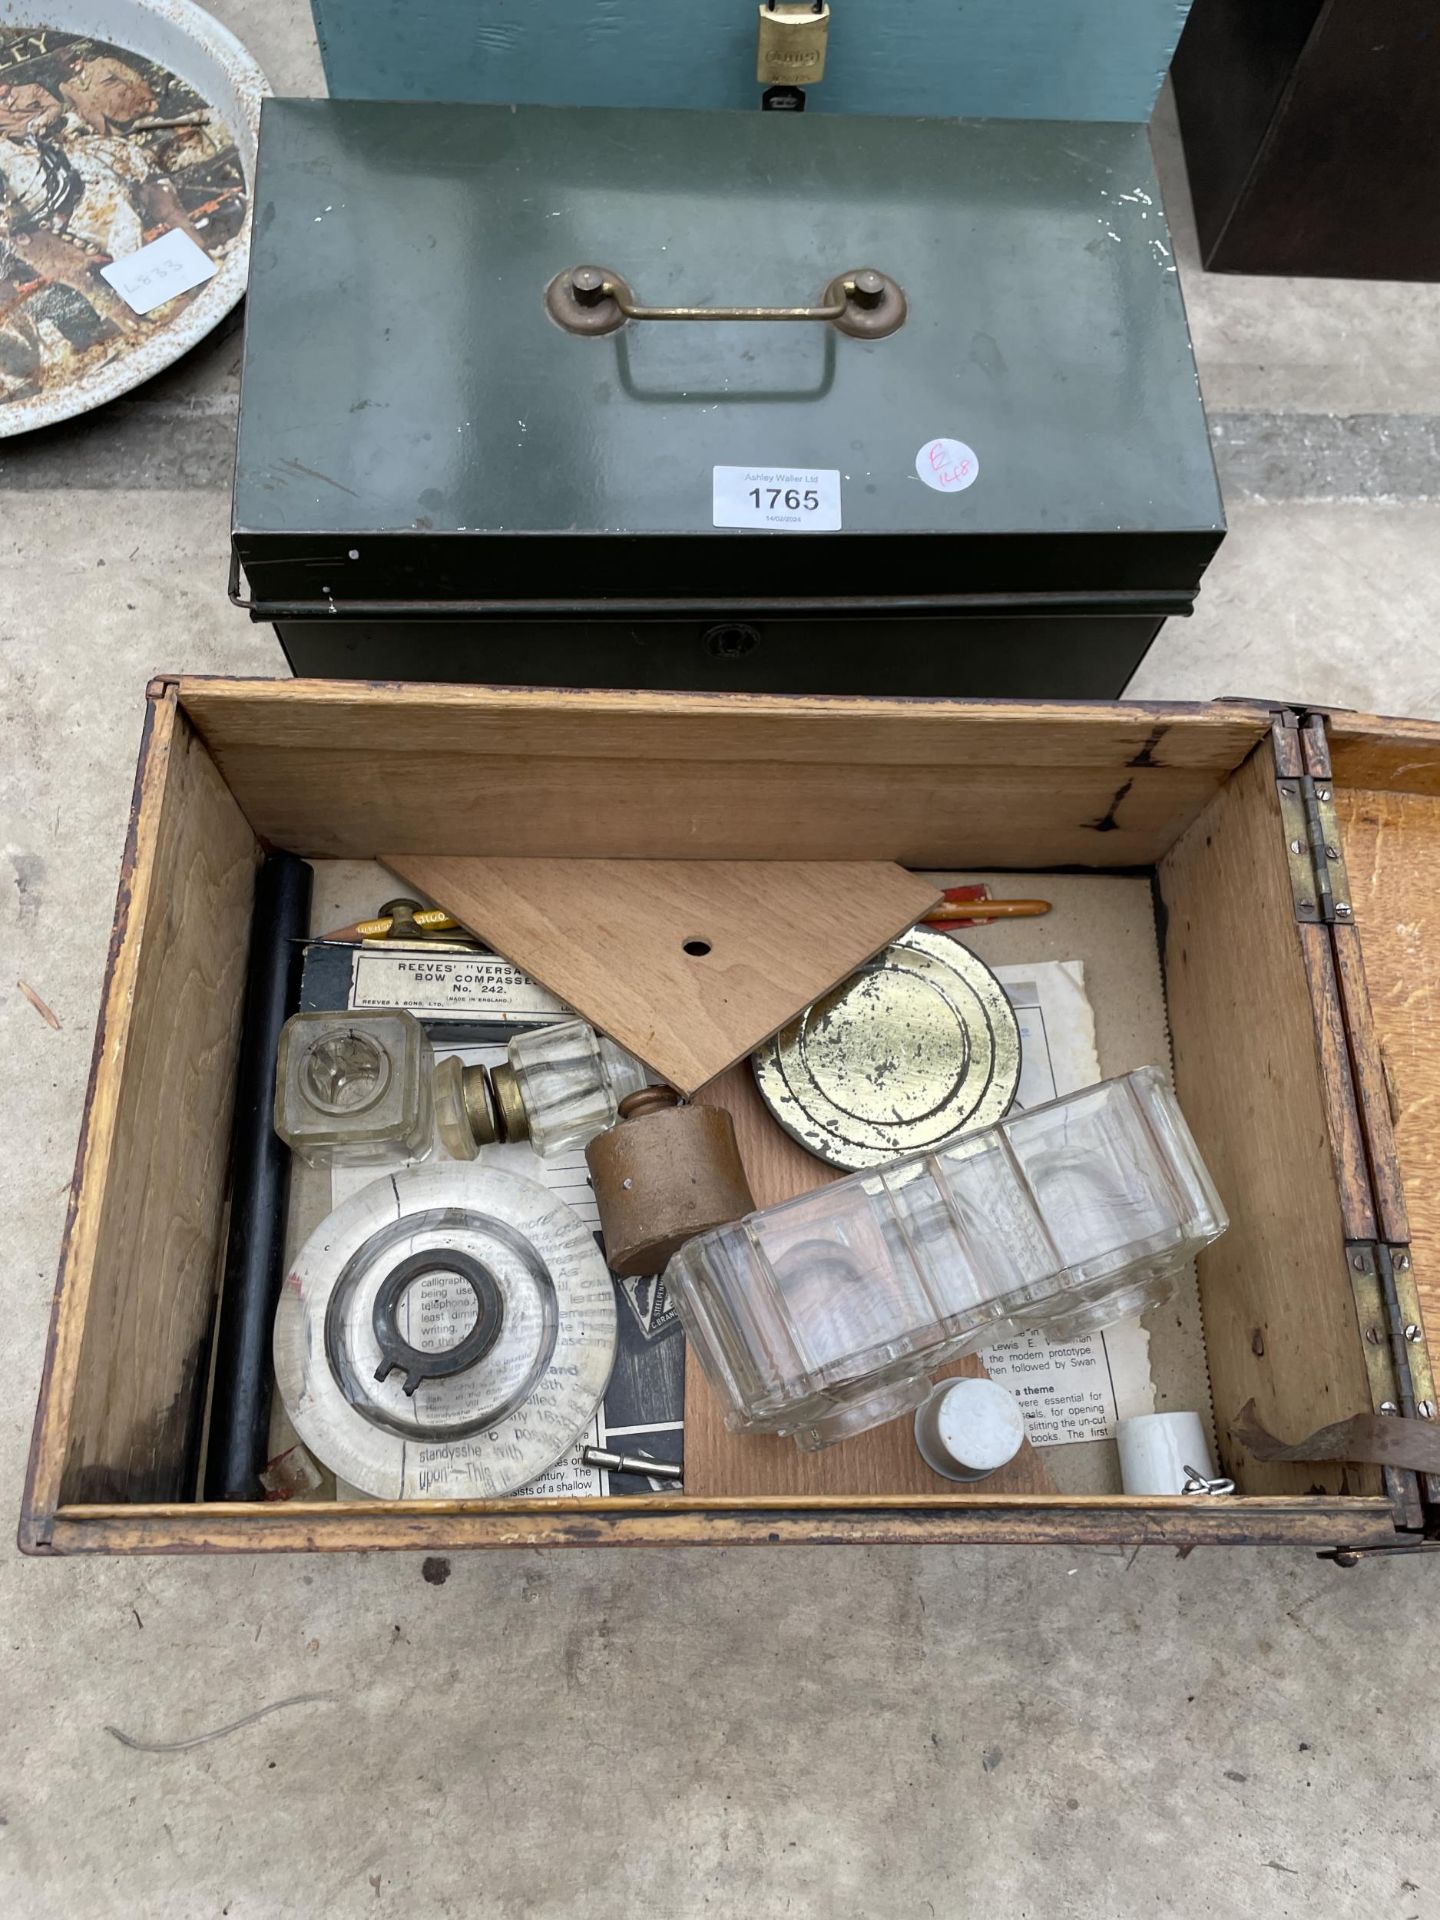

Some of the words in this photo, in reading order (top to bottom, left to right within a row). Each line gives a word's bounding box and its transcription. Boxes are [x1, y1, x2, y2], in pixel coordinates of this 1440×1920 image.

[745, 474, 774, 483] Ashley
[776, 474, 803, 483] Waller
[805, 475, 819, 483] Ltd
[749, 488, 819, 510] 1765
[415, 973, 446, 982] BOW
[453, 984, 472, 993] No.
[481, 985, 507, 994] 242.
[421, 1289, 448, 1299] being
[421, 1312, 444, 1322] least
[421, 1340, 434, 1348] on
[992, 1341, 1019, 1351] Lewis
[989, 1354, 1004, 1363] the
[1012, 1361, 1050, 1373] followed
[1055, 1360, 1066, 1370] by
[1070, 1357, 1096, 1367] Swan
[1024, 1385, 1055, 1396] theme
[1044, 1393, 1084, 1406] essential
[1089, 1392, 1102, 1401] for
[1051, 1408, 1063, 1417] for
[1068, 1404, 1105, 1415] opening
[1028, 1420, 1059, 1431] slitting
[1061, 1419, 1076, 1428] the
[1078, 1416, 1107, 1426] un-cut
[1031, 1432, 1060, 1443] books.
[1067, 1430, 1084, 1440] The
[1091, 1428, 1109, 1438] first
[574, 1467, 592, 1477] The
[536, 1484, 547, 1494] of
[548, 1485, 554, 1493] a
[556, 1481, 593, 1492] shallow
